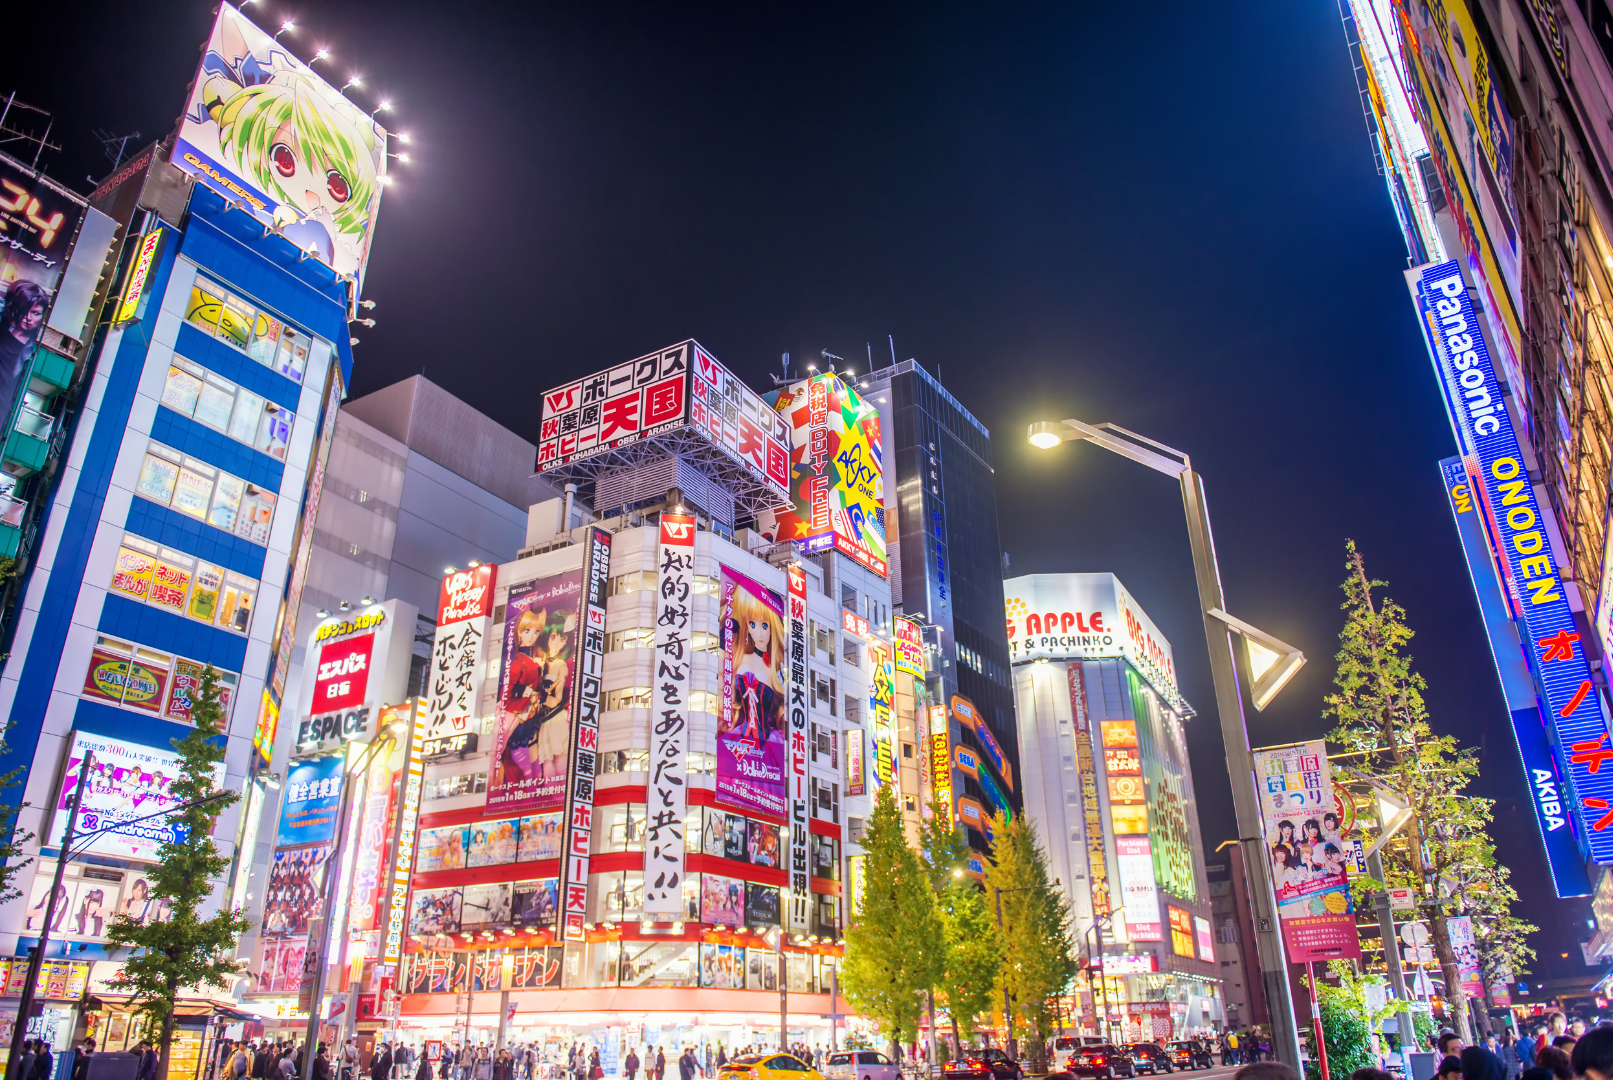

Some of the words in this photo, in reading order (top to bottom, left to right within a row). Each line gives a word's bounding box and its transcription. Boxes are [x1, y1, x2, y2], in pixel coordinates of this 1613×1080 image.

[183, 151, 269, 212] GAMERS
[1430, 274, 1504, 437] Panasonic
[583, 345, 688, 404] ボークス
[600, 371, 686, 442] 天国
[693, 374, 737, 428] 秋葉原
[724, 374, 791, 448] ボークス
[808, 378, 830, 428] 免税店
[542, 404, 600, 440] 秋葉原
[692, 400, 737, 447] ホビー
[537, 459, 563, 473] VOLKS
[563, 443, 610, 465] AKIHABARA
[611, 433, 640, 450] HOBBY
[641, 419, 685, 441] PARADISE
[538, 432, 599, 465] ホビー
[692, 418, 712, 442] VOLKS
[711, 435, 746, 468] AKIHABARA
[745, 460, 765, 483] HOBBY
[738, 412, 790, 490] 天国
[809, 427, 830, 475] DUTY
[140, 480, 172, 501] COMICS
[181, 472, 211, 491] RNET
[858, 482, 876, 501] ONE
[180, 497, 199, 508] cafe
[810, 478, 831, 531] FREE
[838, 537, 856, 555] AKKY
[1491, 456, 1561, 606] ONODEN
[119, 551, 153, 574] インター
[156, 564, 189, 586] ネット
[588, 531, 602, 604] PARADISE
[599, 533, 611, 583] HOBBY
[112, 571, 150, 596] まんが
[151, 583, 185, 608] 喫茶
[442, 605, 482, 625] Paradise
[844, 612, 868, 638] 免税
[1025, 638, 1036, 649] &
[1041, 635, 1113, 648] PACHINKO
[97, 668, 156, 694] WELCOME
[317, 652, 367, 681] エスパス
[873, 646, 890, 705] TAX
[297, 708, 370, 746] ESPACE
[874, 706, 893, 783] FREE
[958, 751, 976, 770] SEGA
[1264, 754, 1320, 776] 秋葉原
[1267, 771, 1323, 793] 電気街
[1272, 789, 1322, 809] まつり
[1532, 768, 1566, 832] AKIBA
[1117, 839, 1149, 848] Pachinko
[1126, 846, 1141, 855] Slot
[1353, 843, 1367, 873] スロット
[855, 873, 863, 892] TAX
[1128, 931, 1161, 940] Pachinko
[1135, 923, 1151, 931] Slot
[1131, 1003, 1144, 1012] BIG
